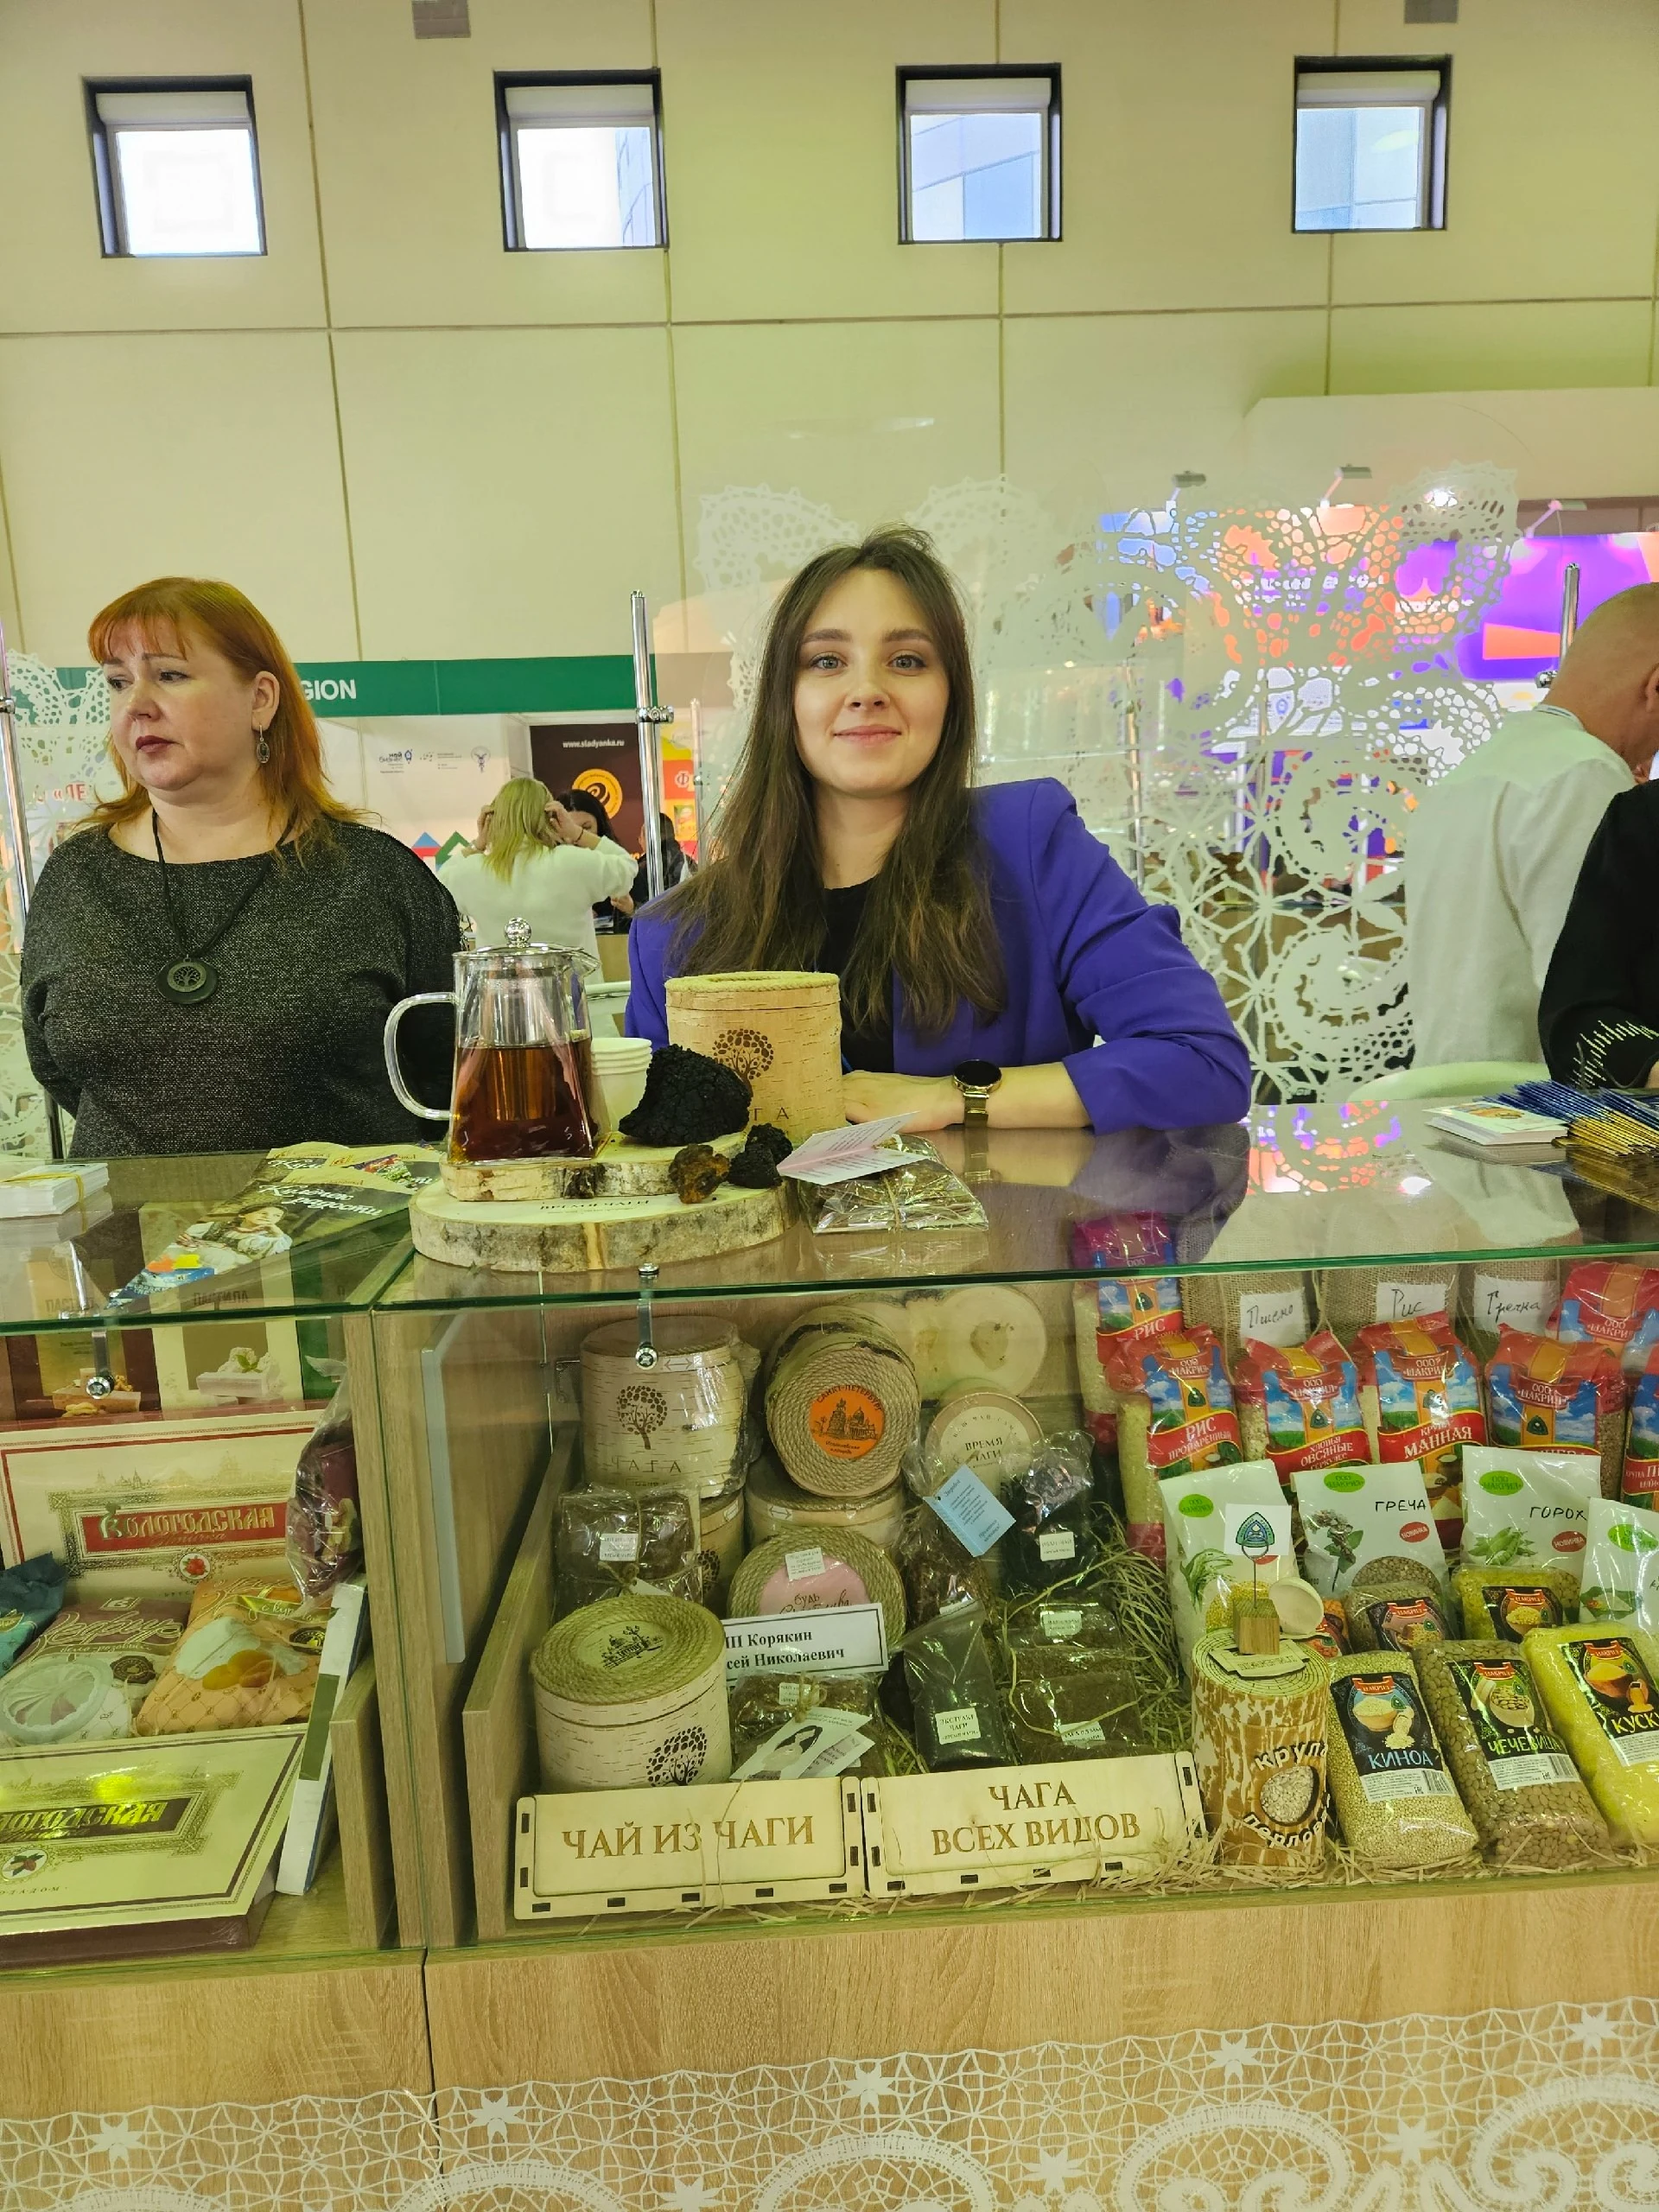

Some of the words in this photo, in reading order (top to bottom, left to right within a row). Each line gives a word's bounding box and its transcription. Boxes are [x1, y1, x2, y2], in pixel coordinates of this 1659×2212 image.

[1391, 1288, 1426, 1318] Рис
[1134, 1318, 1166, 1340] РИС
[1604, 1319, 1626, 1330] ООО
[1179, 1357, 1198, 1367] ООО
[1303, 1378, 1323, 1388] ООО
[816, 1384, 883, 1411] САНКТ-ПЕТЕРБУРГ
[1185, 1416, 1217, 1441] РИС
[964, 1437, 1003, 1451] ВРЕМЯ
[1309, 1436, 1342, 1452] ХЛОПЬЯ
[1403, 1426, 1473, 1459] МАННАЯ
[1300, 1442, 1354, 1467] ОВСЯНЫЕ
[1375, 1499, 1427, 1512] ГРЕЧА
[1529, 1506, 1588, 1521] ГОРОХ
[1401, 1526, 1428, 1540] НОВИНКА
[1554, 1537, 1585, 1548] НОВИНКА
[794, 1592, 820, 1607] будь
[747, 1630, 813, 1649] Корякин
[754, 1648, 844, 1667] Николаевич
[939, 1714, 975, 1726] ЭКСТРАКТ
[1487, 1736, 1561, 1755] ЧЕЧЕВИЦА
[1368, 1751, 1434, 1770] КИНОА
[988, 1780, 1077, 1811] ЧАГА
[562, 1821, 644, 1859] ЧАЙ
[653, 1822, 702, 1854] ИЗ
[713, 1815, 815, 1850] ЧАГИ
[931, 1822, 1019, 1856] ВСЕХ
[1025, 1813, 1141, 1848] ВИДОВ
